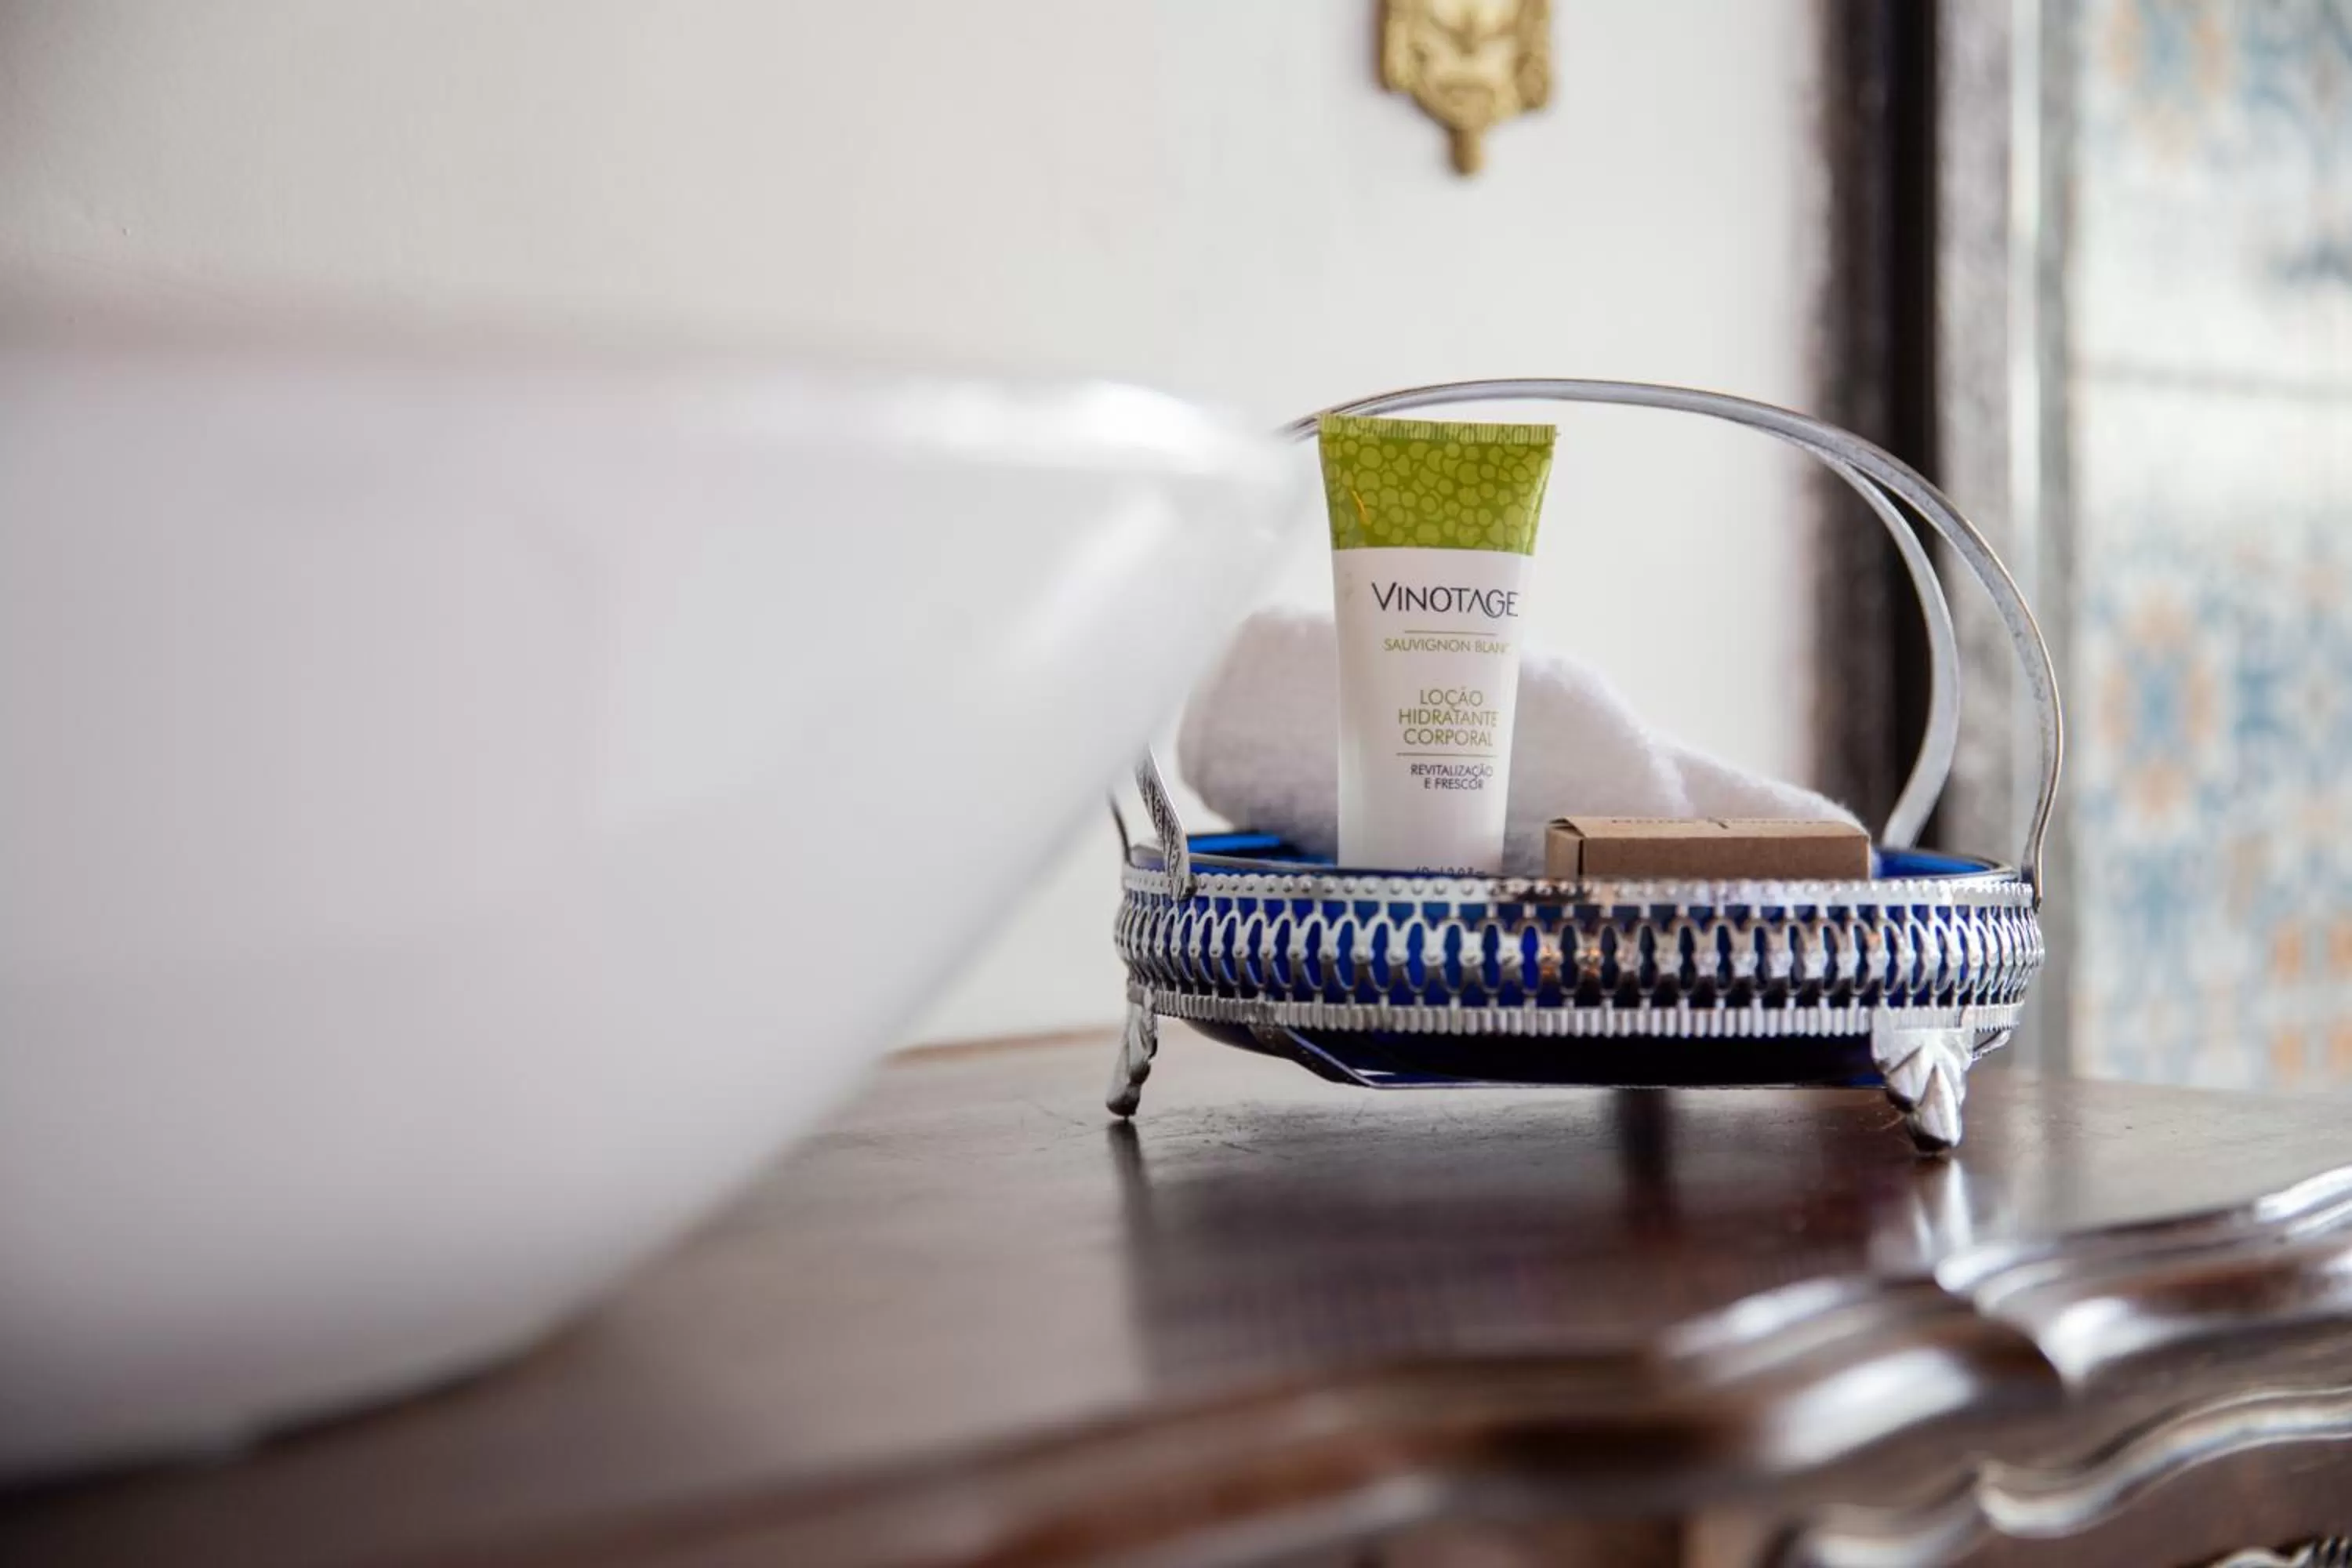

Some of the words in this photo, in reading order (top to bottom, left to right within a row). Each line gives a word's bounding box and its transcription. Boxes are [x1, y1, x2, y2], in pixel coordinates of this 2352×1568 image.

[1371, 581, 1519, 618] VINOTAGE
[1384, 638, 1471, 653] SAUVIGNON
[1420, 687, 1484, 710] LOÇÃO
[1398, 709, 1499, 727] HIDRATANTE
[1403, 728, 1494, 747] CORPORAL
[1410, 764, 1493, 779] REVITALIZAÇÃO
[1424, 777, 1431, 789] E
